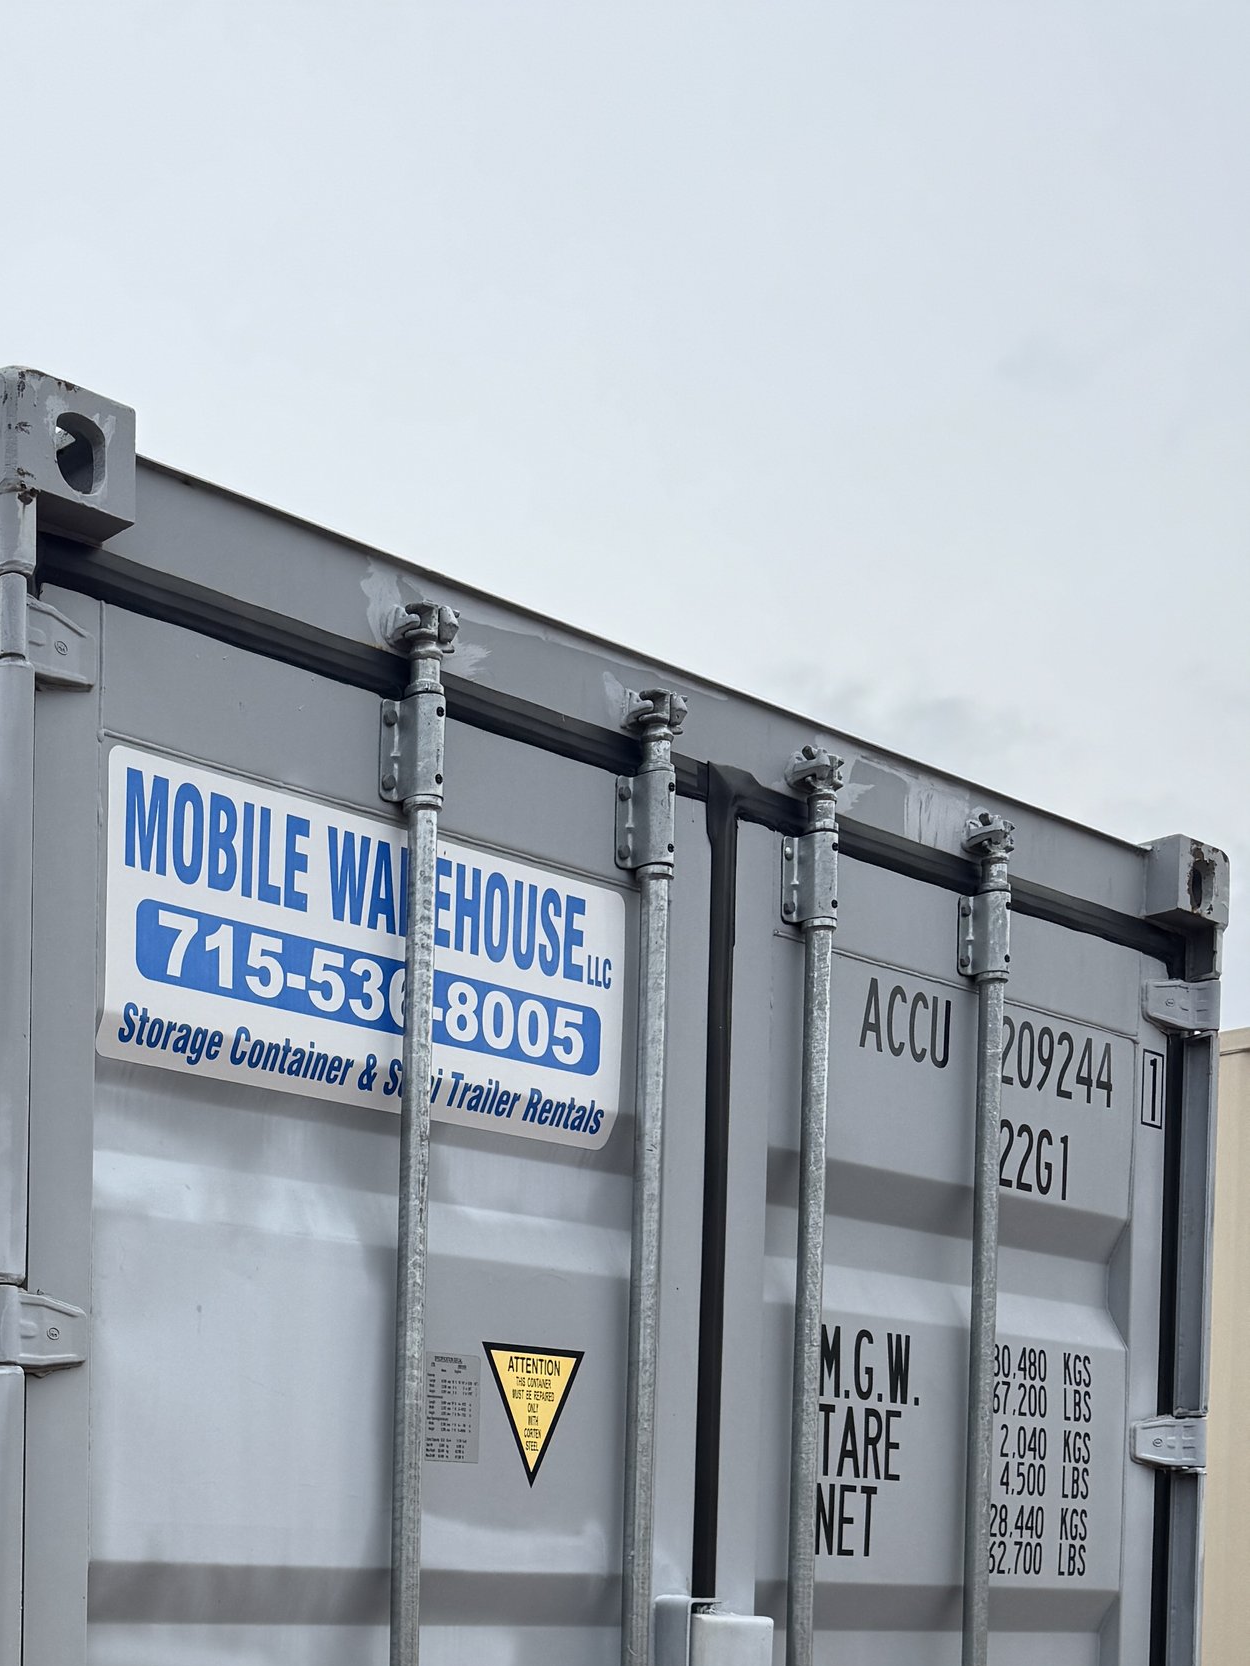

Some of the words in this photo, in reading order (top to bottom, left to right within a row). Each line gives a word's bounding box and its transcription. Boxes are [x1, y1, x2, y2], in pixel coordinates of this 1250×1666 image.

[125, 767, 310, 912] MOBILE
[327, 825, 585, 983] WAEHOUSE
[587, 955, 612, 990] LLC
[859, 977, 951, 1068] ACCU
[1001, 1015, 1113, 1108] 209244
[118, 1002, 224, 1065] Storage
[230, 1026, 355, 1086] Container
[357, 1053, 378, 1092] &
[383, 1058, 444, 1104] Si
[446, 1071, 522, 1119] Trailer
[521, 1087, 605, 1135] Rentals
[999, 1119, 1069, 1200] 22G1
[507, 1355, 561, 1377] ATTENTION
[516, 1376, 526, 1387] THIS
[527, 1377, 552, 1389] CONTAINER
[819, 1324, 919, 1406] M.G.W.
[1063, 1352, 1091, 1388] KGS
[512, 1388, 525, 1400] MUST
[533, 1390, 555, 1402] REPAIRED
[527, 1402, 539, 1413] ONLY
[1064, 1388, 1091, 1423] LBS
[525, 1440, 539, 1452] STEEL
[818, 1403, 902, 1481] TARE
[1063, 1430, 1091, 1465] KGS
[1061, 1466, 1089, 1500] LBS
[815, 1483, 877, 1557] NET
[1060, 1507, 1088, 1542] KGS
[1058, 1543, 1086, 1577] LBS
